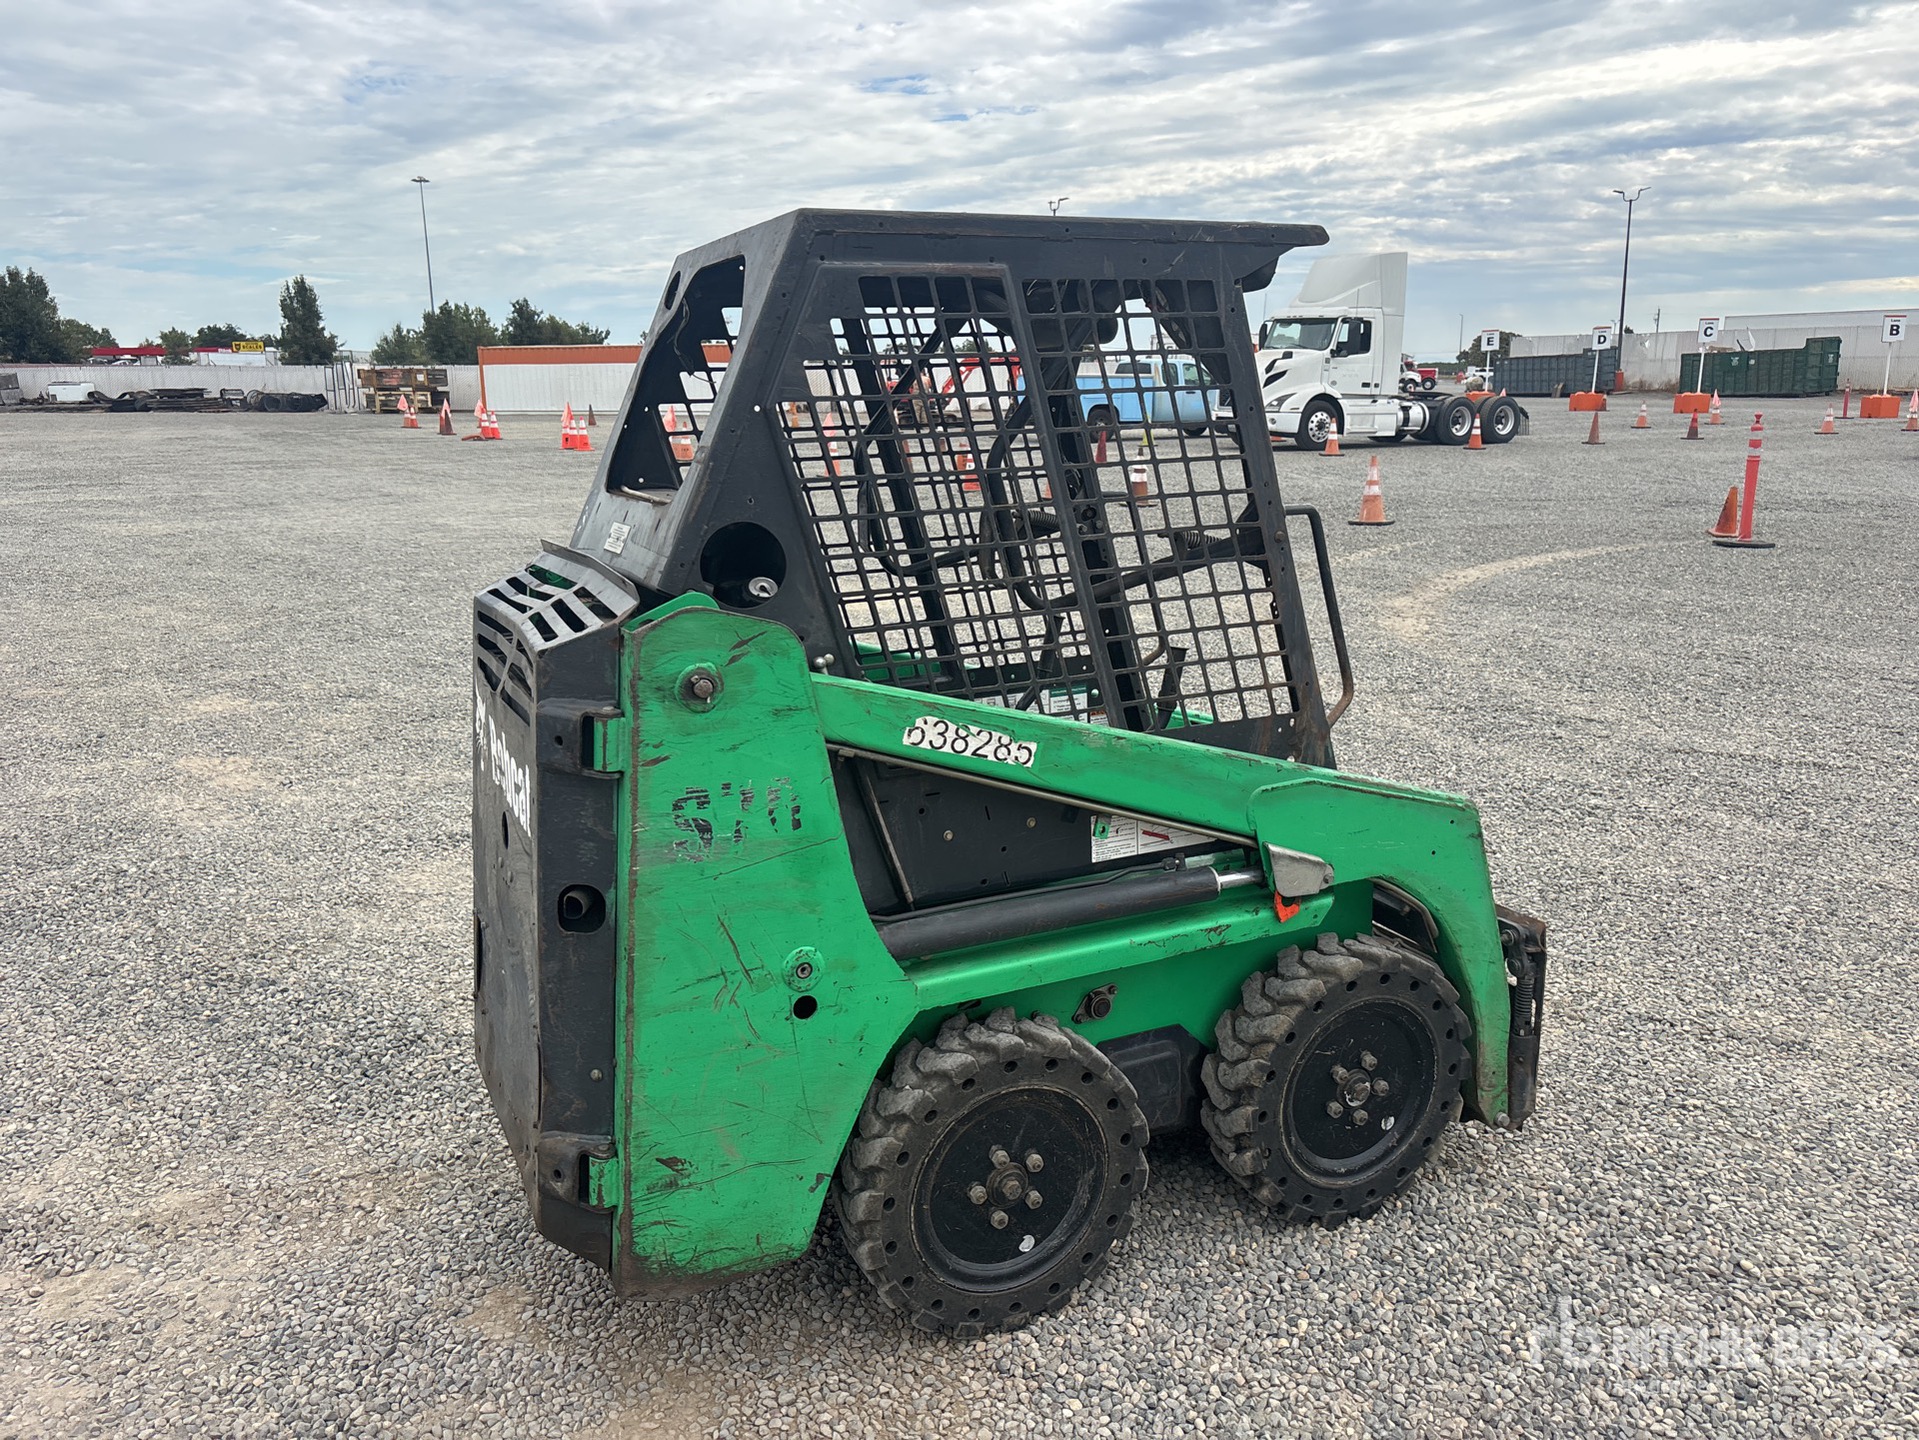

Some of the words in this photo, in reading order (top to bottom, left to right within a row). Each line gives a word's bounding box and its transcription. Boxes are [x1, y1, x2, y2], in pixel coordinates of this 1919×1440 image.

[1703, 326, 1714, 337] C
[1889, 324, 1900, 336] B
[1486, 336, 1495, 346] E
[1597, 334, 1607, 345] D
